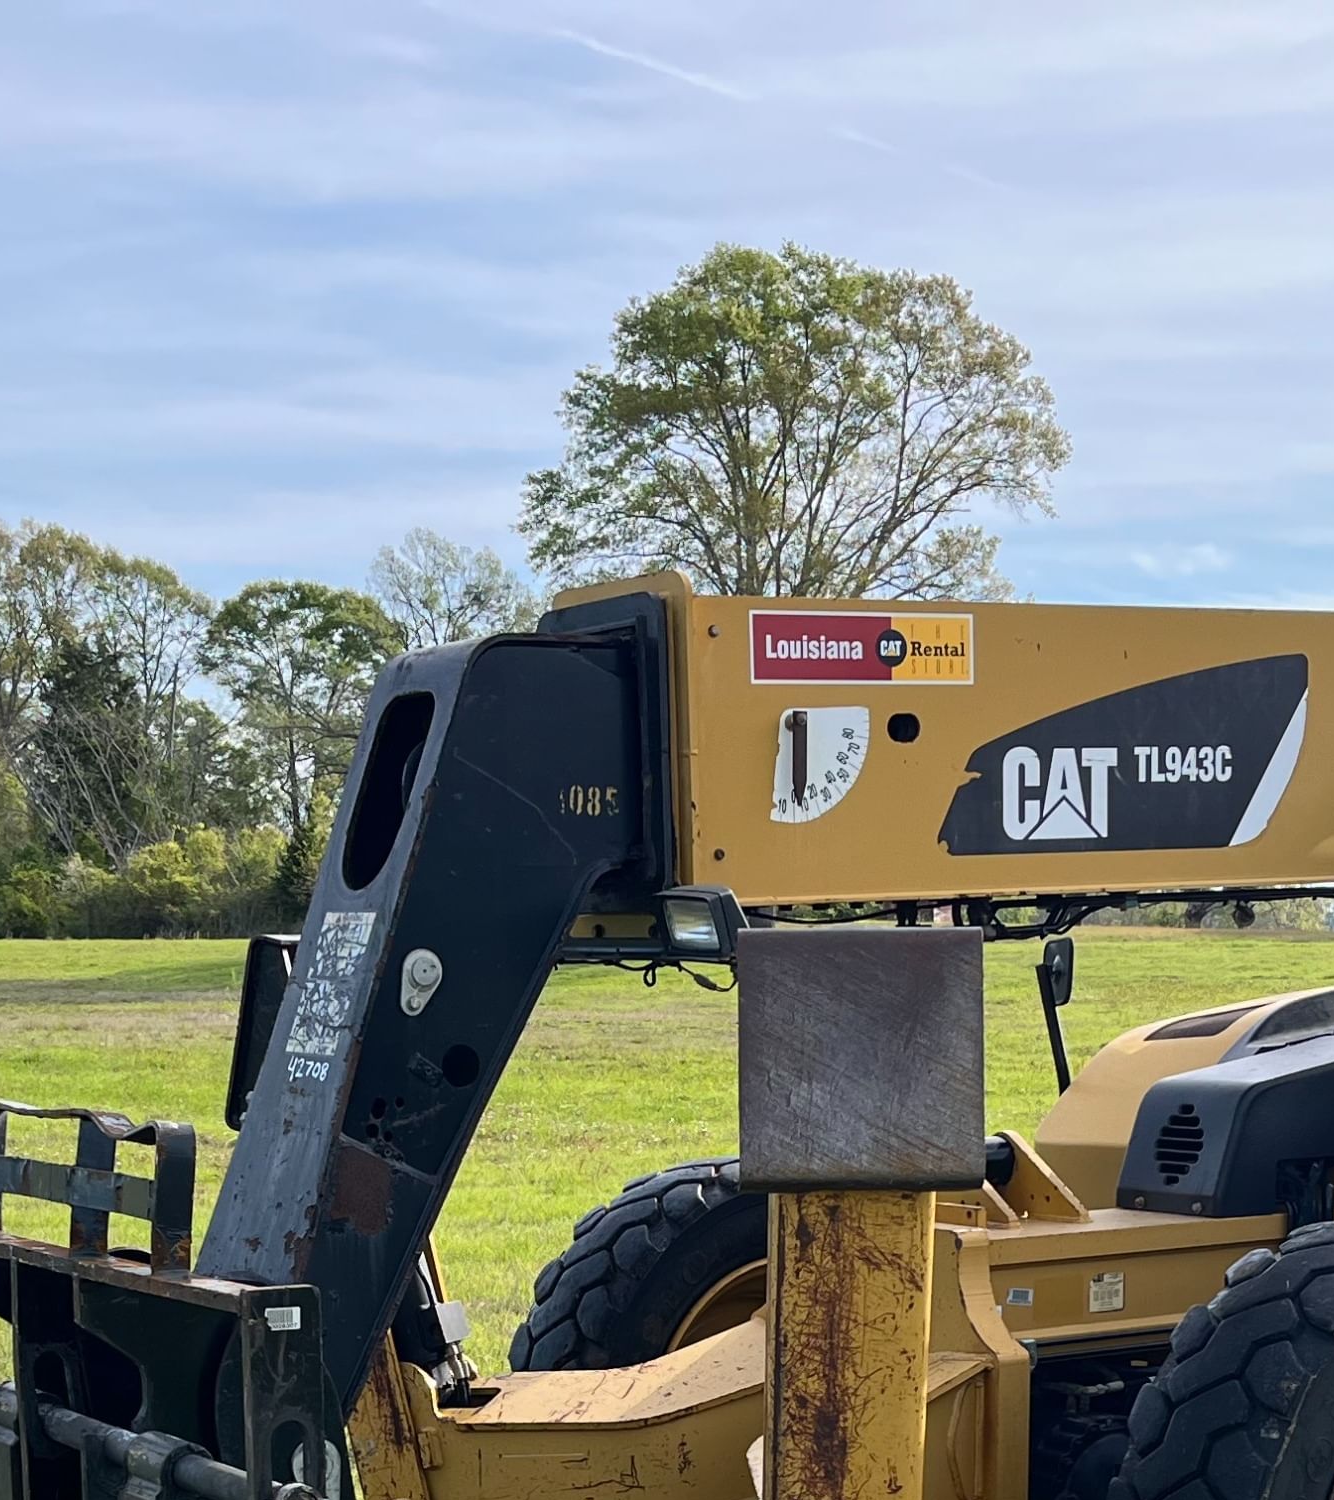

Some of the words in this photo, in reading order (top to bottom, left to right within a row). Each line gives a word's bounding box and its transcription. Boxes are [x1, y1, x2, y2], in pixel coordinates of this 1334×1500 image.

[765, 634, 863, 660] Louisiana
[880, 640, 902, 657] CAT
[910, 641, 966, 657] Rental
[842, 727, 855, 740] 80
[847, 742, 860, 755] 70
[807, 783, 818, 800] 20
[820, 786, 832, 802] 30
[1002, 746, 1118, 840] CAT
[1133, 745, 1233, 783] TL943C
[287, 1055, 330, 1082] 42708
